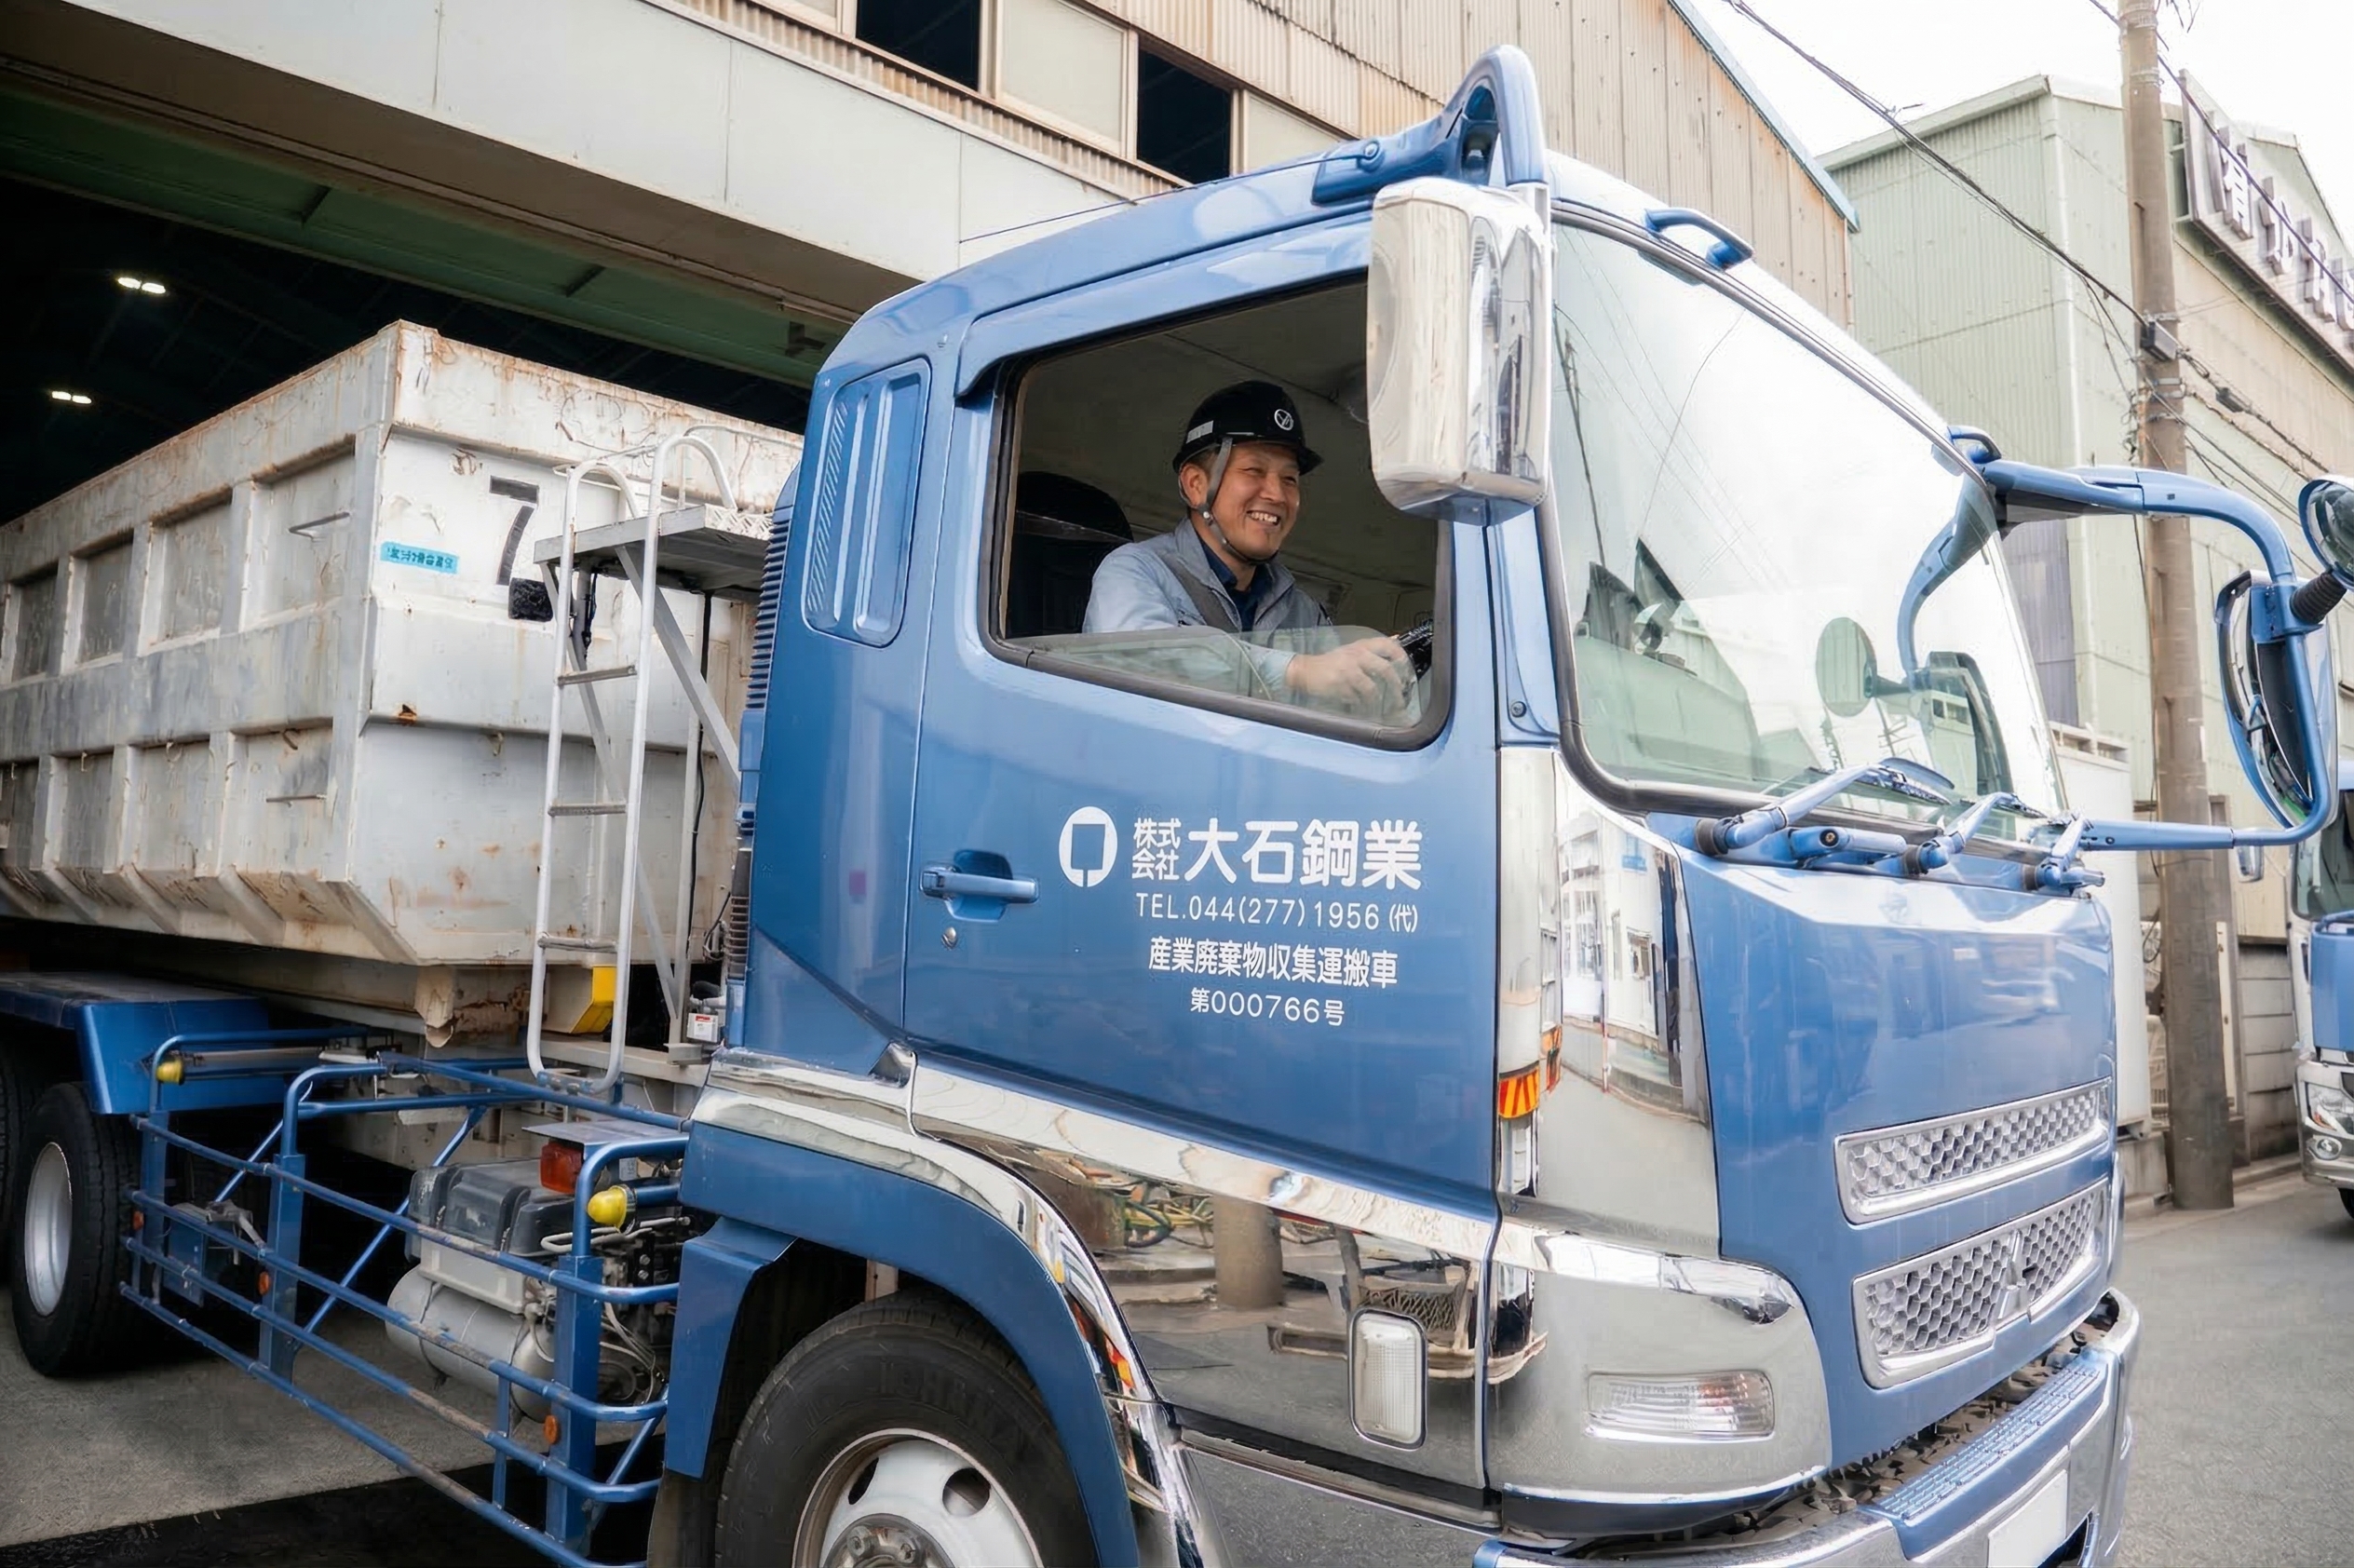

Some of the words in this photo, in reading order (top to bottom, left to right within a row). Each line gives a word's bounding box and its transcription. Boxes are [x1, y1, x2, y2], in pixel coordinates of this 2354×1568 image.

[490, 475, 539, 586] 7
[1133, 818, 1182, 849] 株式
[1184, 818, 1422, 891] 大石鋼業
[1131, 848, 1180, 881] 会社
[1136, 892, 1380, 931] TEL.044(277)1956
[1388, 903, 1419, 934] (代)
[1148, 936, 1399, 990] 産業廃棄物収集運搬車
[1190, 987, 1346, 1027] 第000766号
